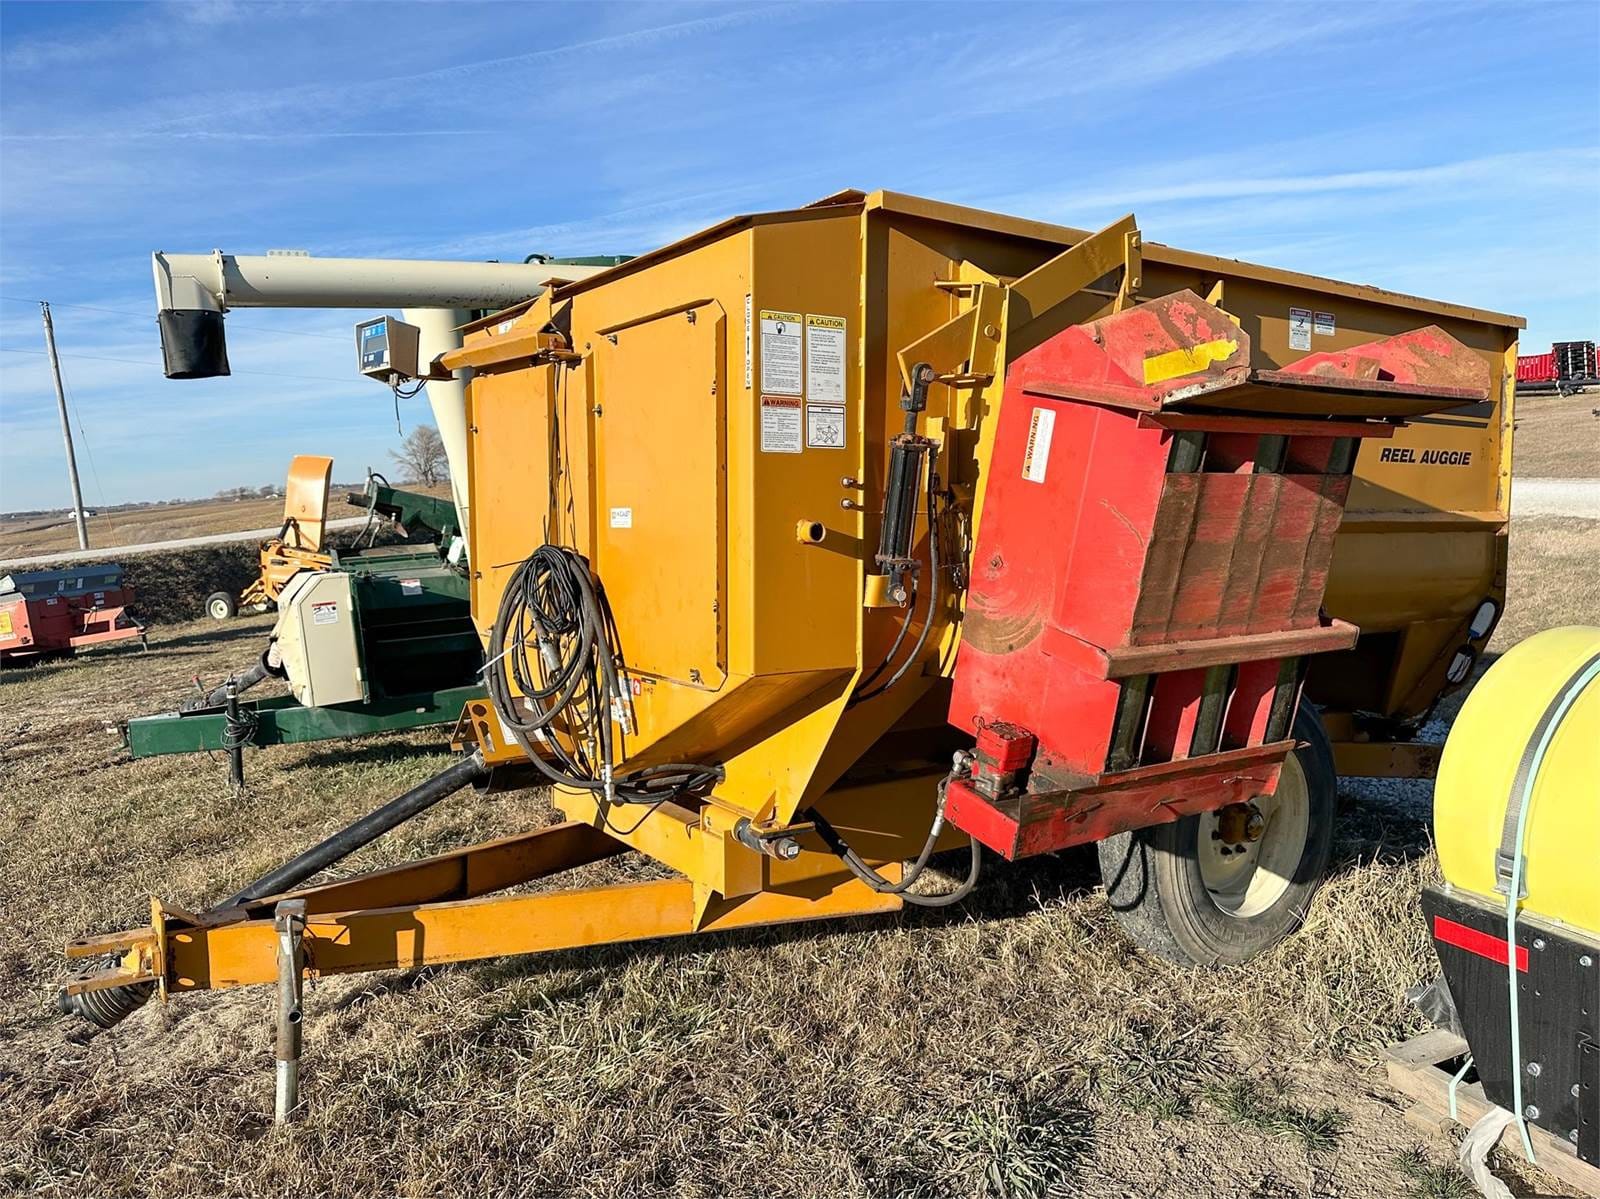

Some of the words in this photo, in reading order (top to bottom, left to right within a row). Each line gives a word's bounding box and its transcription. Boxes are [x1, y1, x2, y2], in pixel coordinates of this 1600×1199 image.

[815, 318, 843, 328] CAUTION
[770, 399, 800, 408] WARNING
[1026, 415, 1040, 460] WARNING
[1380, 447, 1416, 463] REEL
[1420, 449, 1472, 466] AUGGIE
